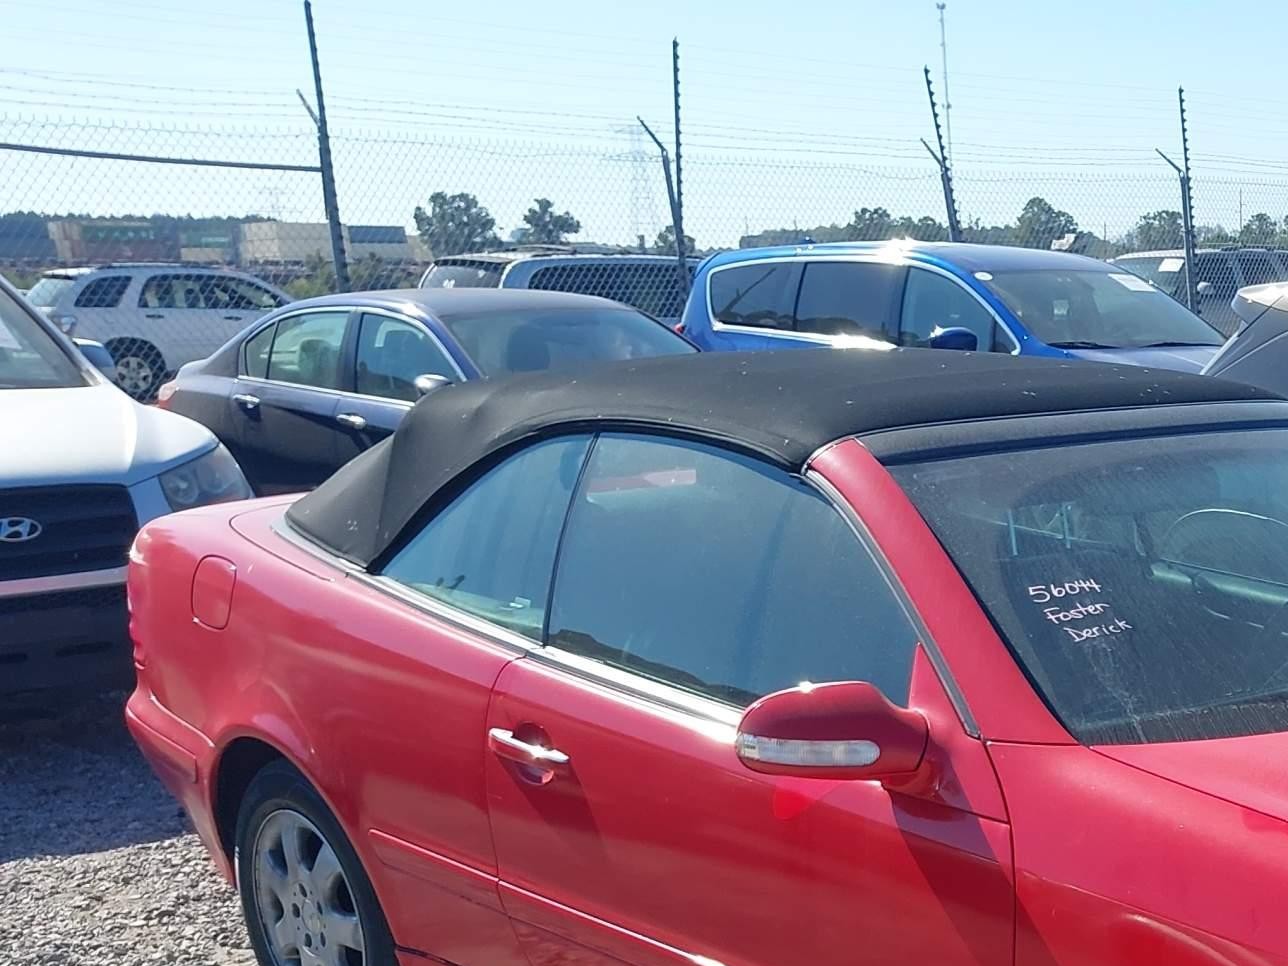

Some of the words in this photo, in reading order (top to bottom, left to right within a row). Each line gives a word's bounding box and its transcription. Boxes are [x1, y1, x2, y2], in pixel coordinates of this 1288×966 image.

[1028, 578, 1102, 603] 56044
[1043, 602, 1111, 625] Foster
[1063, 618, 1133, 642] Derick
